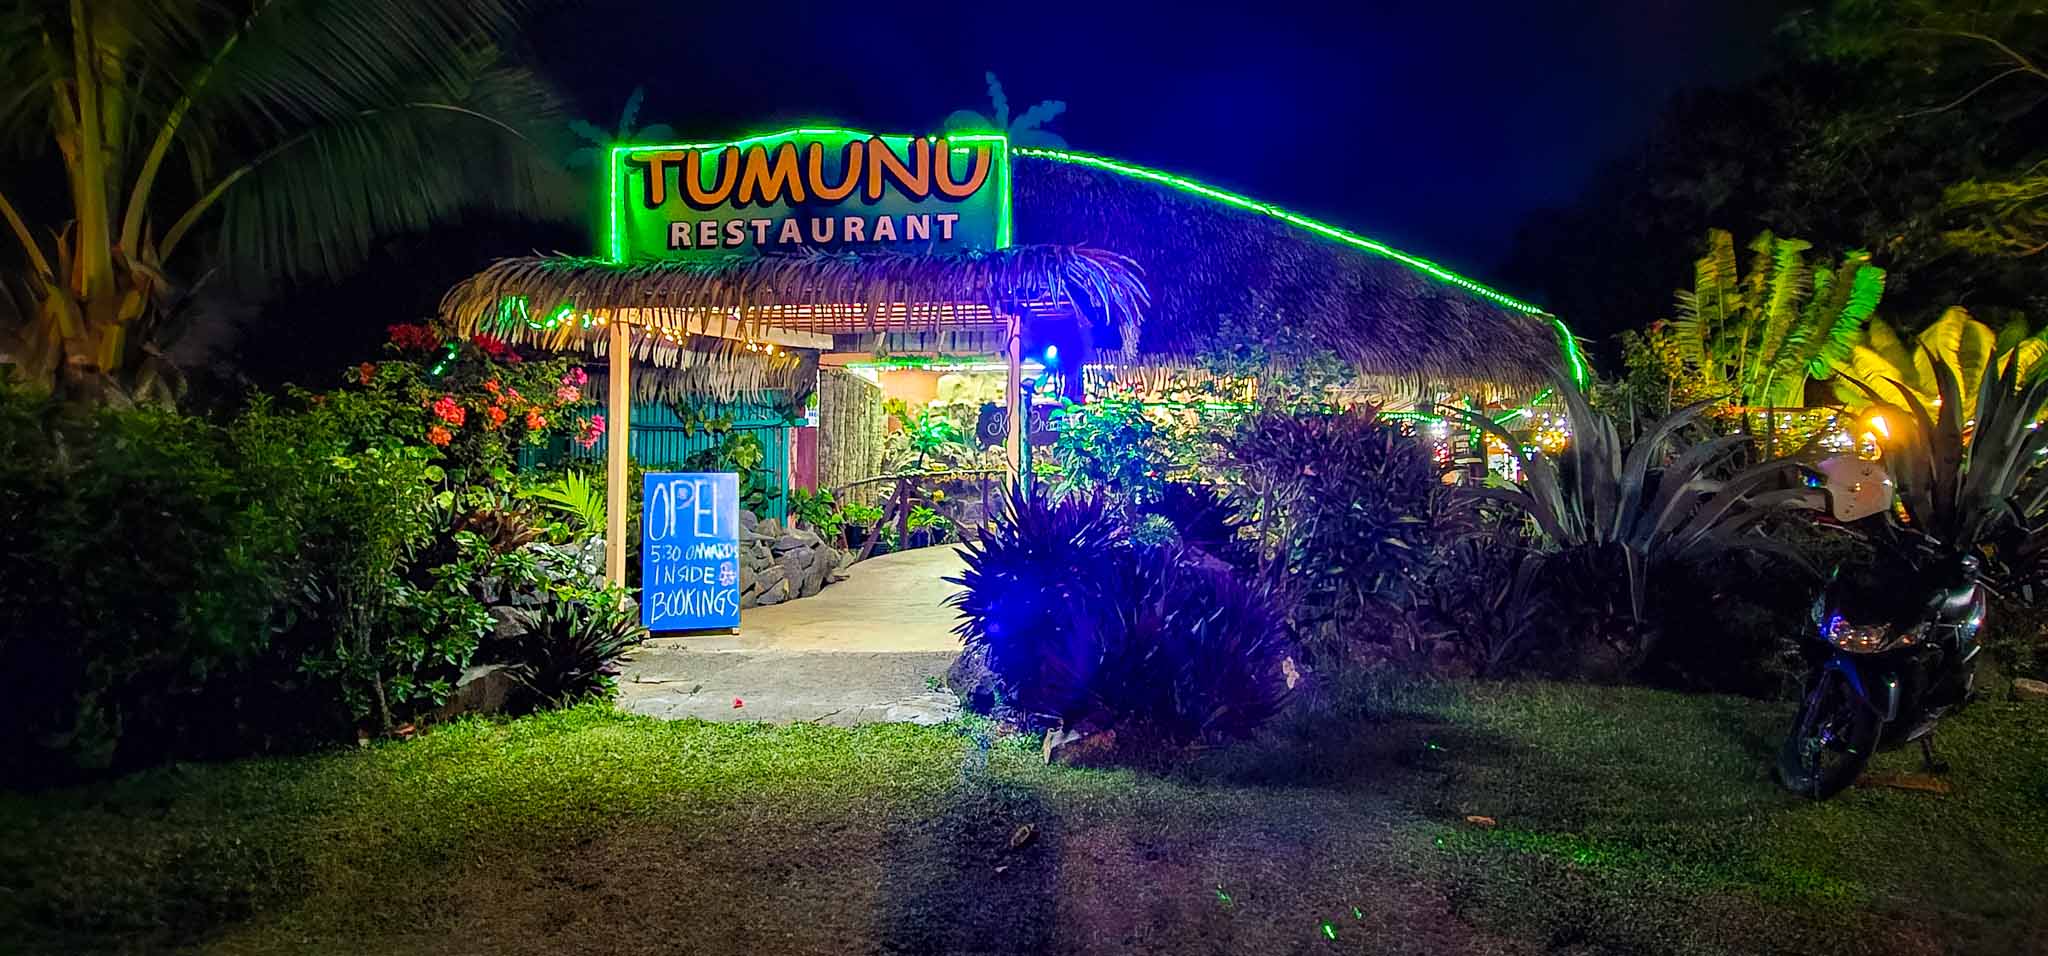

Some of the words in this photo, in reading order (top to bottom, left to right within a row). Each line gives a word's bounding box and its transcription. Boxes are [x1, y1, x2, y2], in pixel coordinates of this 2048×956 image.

[627, 136, 993, 208] TUMUNU
[669, 213, 960, 248] RESTAURANT
[651, 544, 681, 563] 5:30
[654, 564, 715, 586] INSIDE
[651, 587, 739, 624] BOOKINGS
